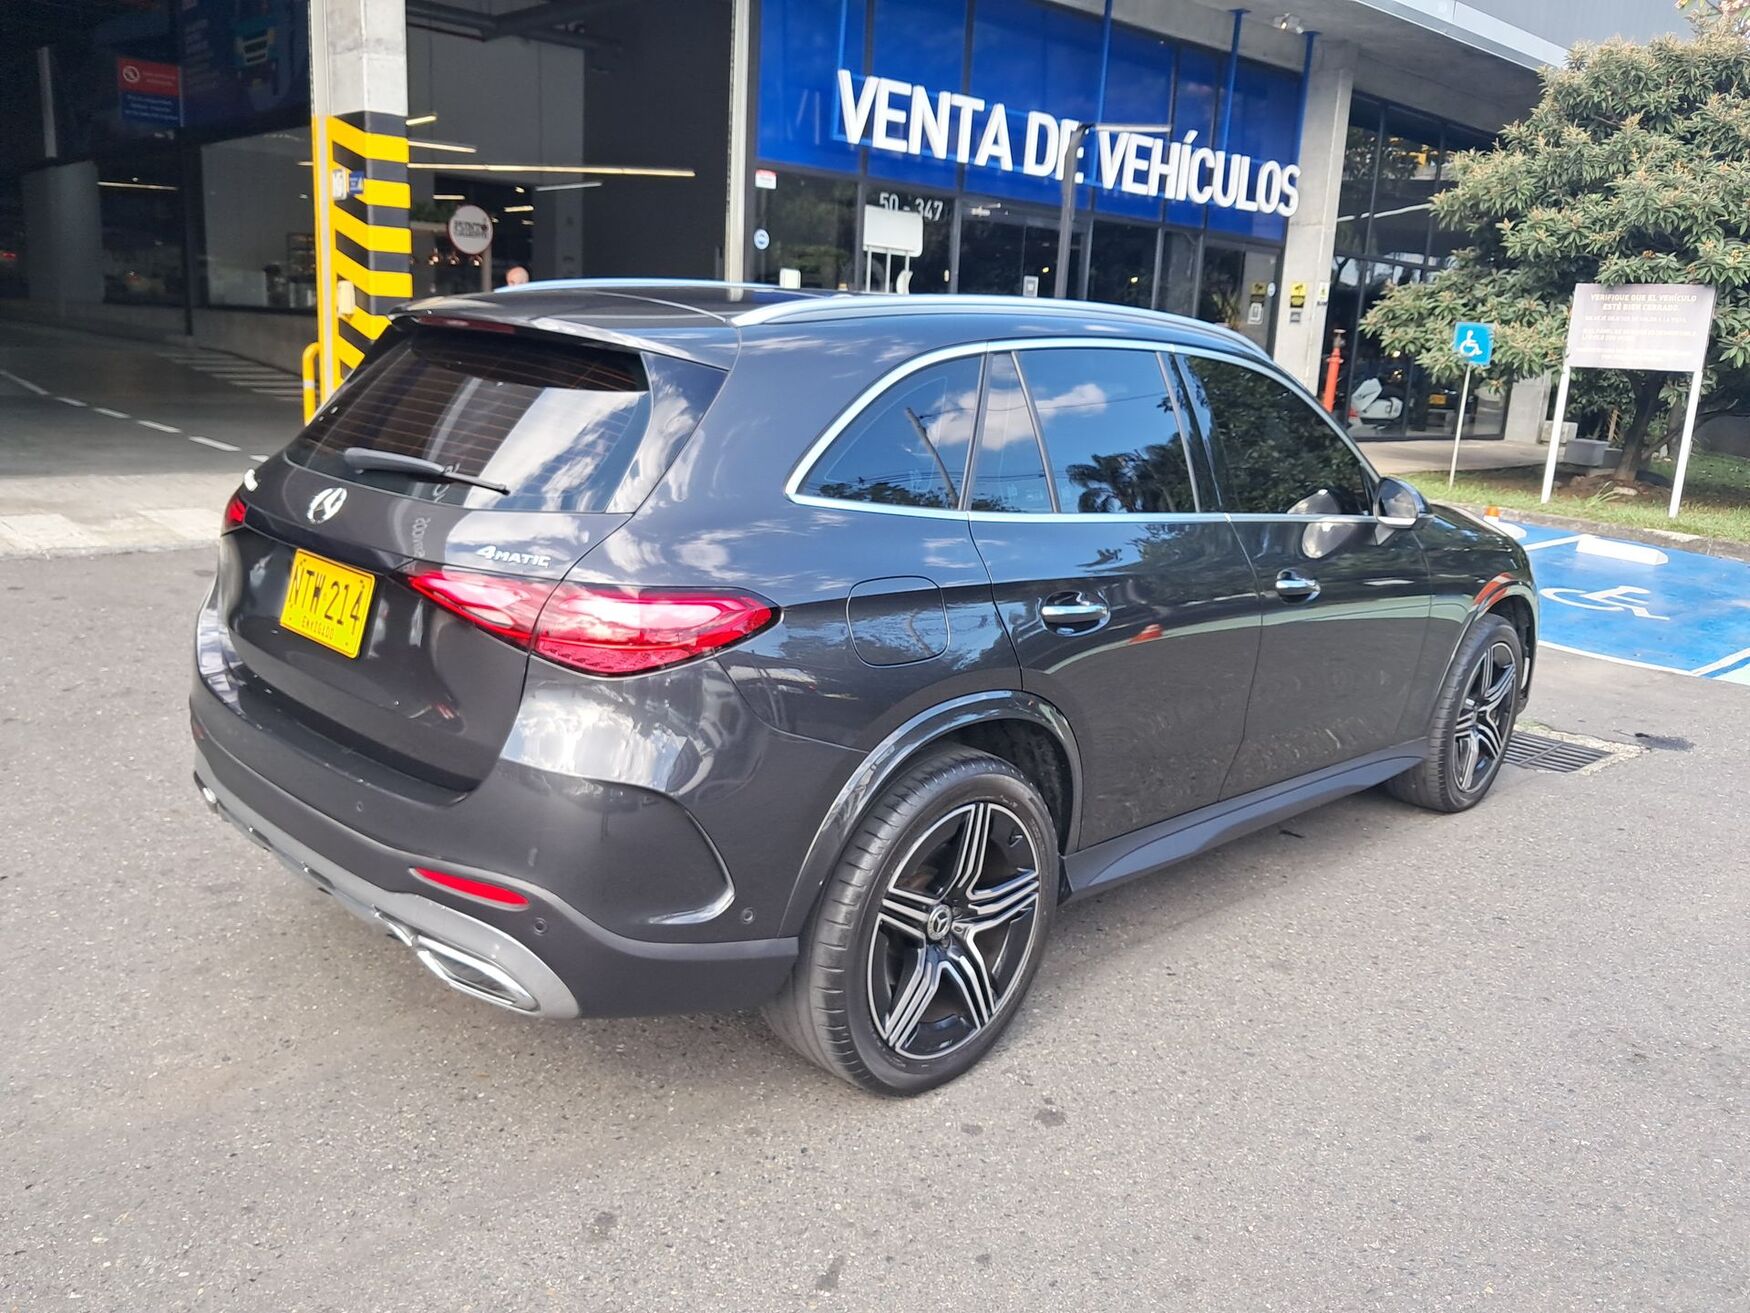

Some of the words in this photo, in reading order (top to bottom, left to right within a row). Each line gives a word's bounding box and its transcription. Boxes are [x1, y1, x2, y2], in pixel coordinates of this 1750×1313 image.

[837, 69, 1012, 171] VENTA
[1023, 111, 1085, 184] DE
[1098, 130, 1301, 217] VEHÍCULOS
[880, 187, 900, 212] 50
[914, 197, 944, 221] 347
[1591, 293, 1630, 302] VERIFIQUE
[1630, 294, 1647, 302] QUE
[1659, 292, 1697, 304] VEHÍCULO
[475, 545, 552, 567] 4MATIC
[324, 580, 364, 636] 214
